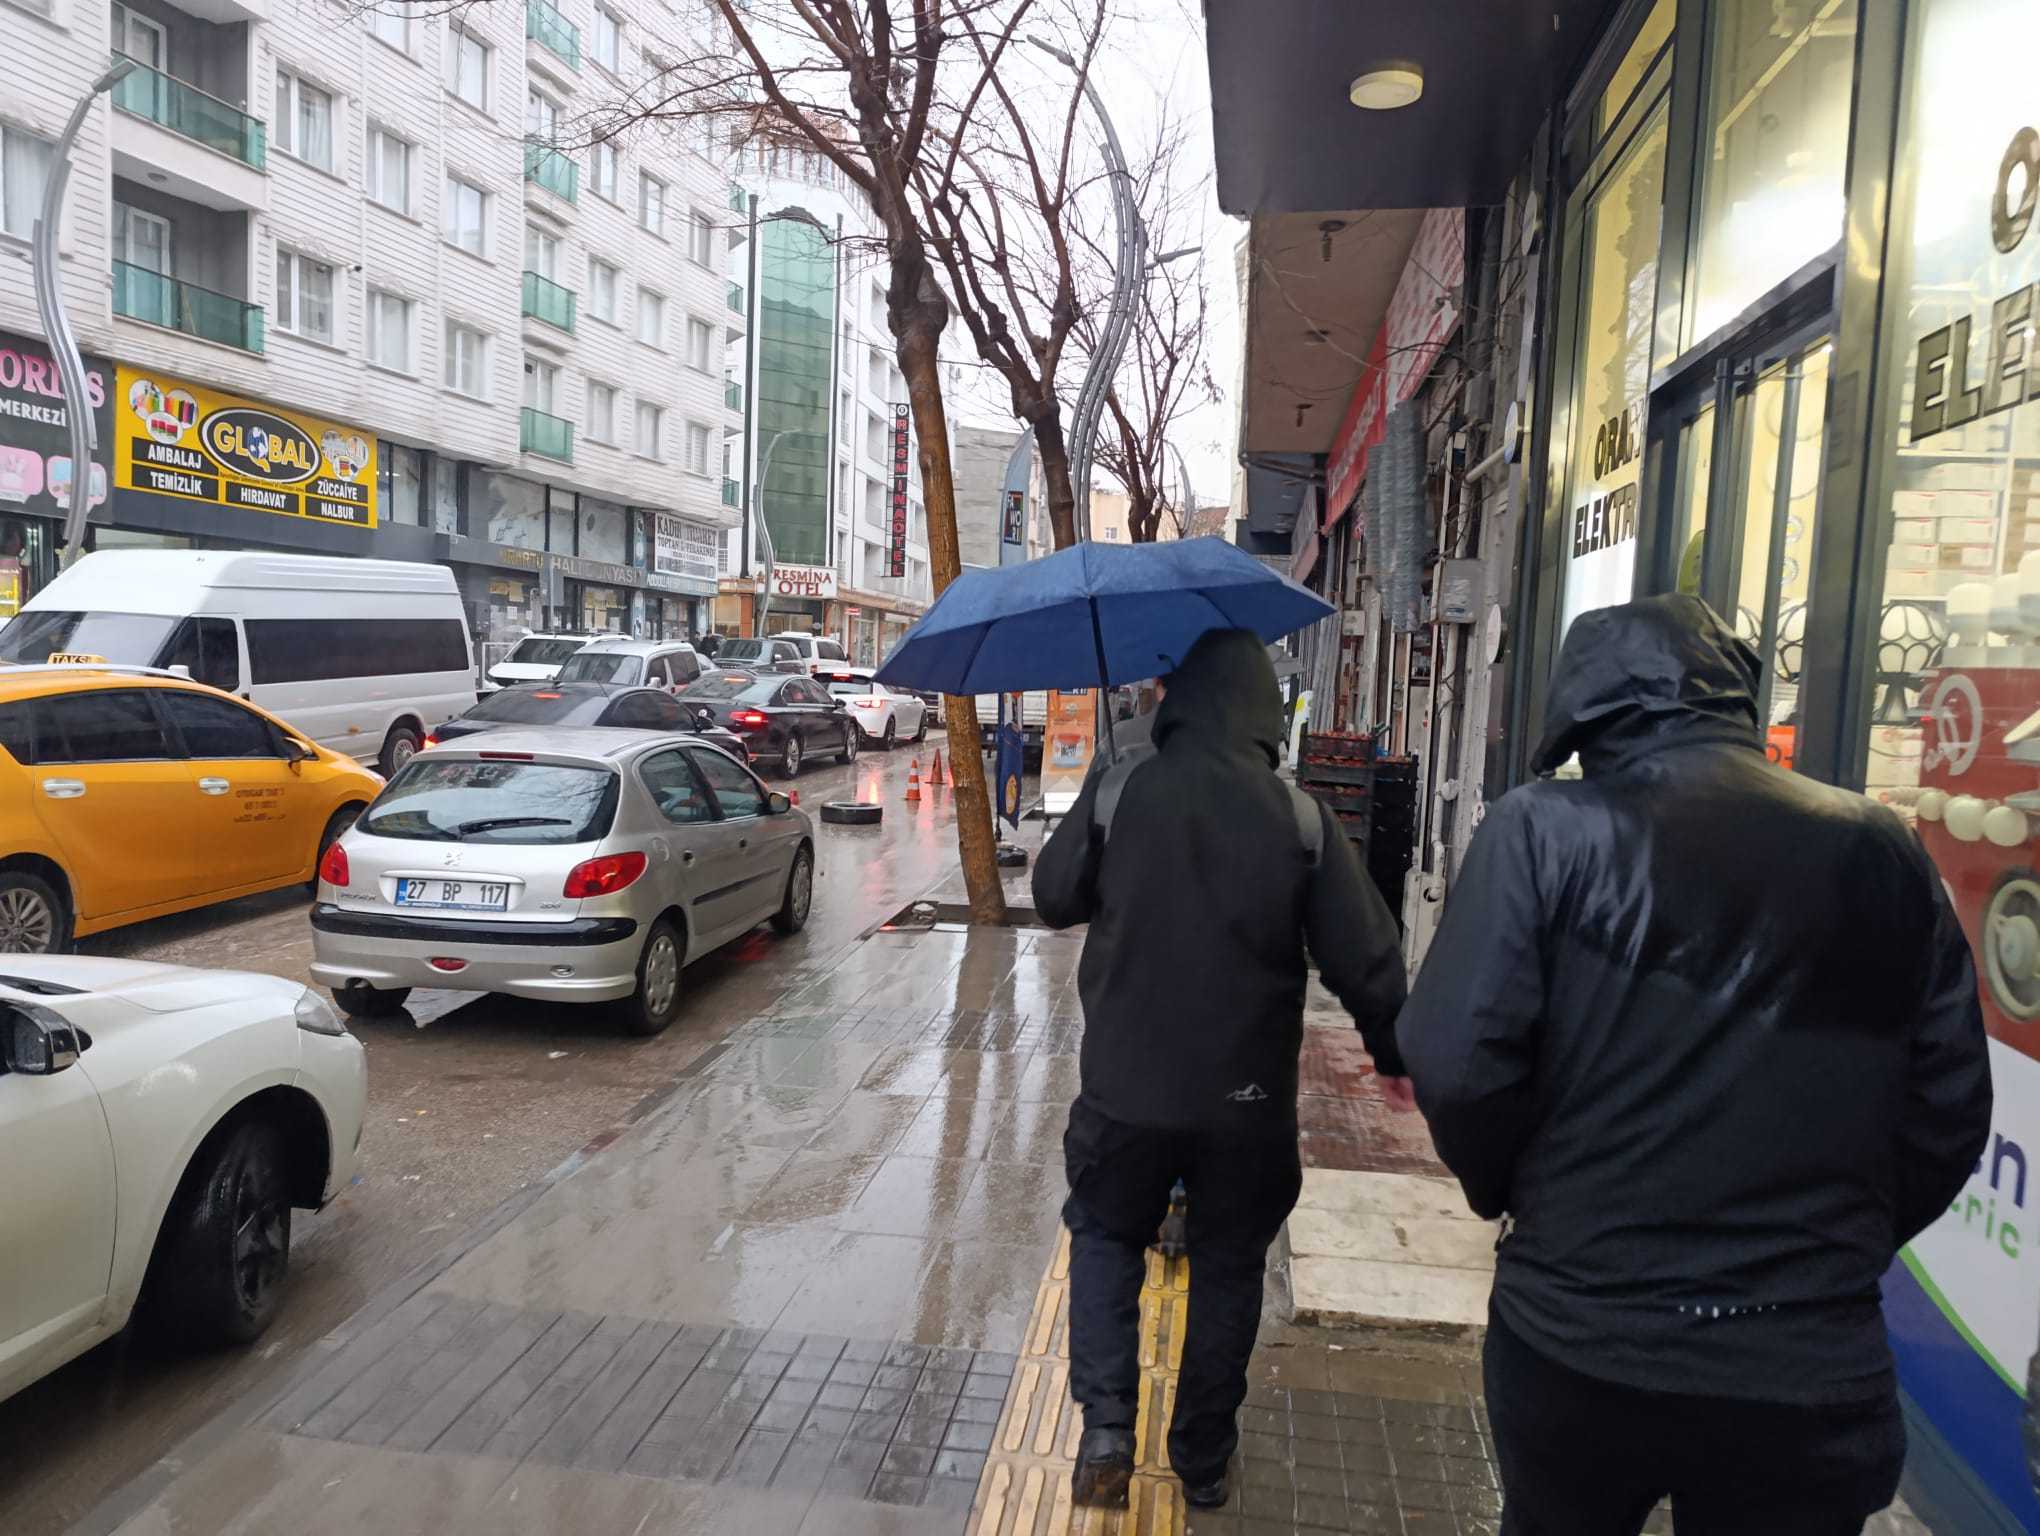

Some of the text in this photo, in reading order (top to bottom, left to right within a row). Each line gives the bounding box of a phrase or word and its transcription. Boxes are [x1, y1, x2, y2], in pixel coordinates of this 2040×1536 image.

[1910, 280, 2040, 442] ELE
[148, 444, 202, 469] AMBALAJ
[213, 422, 311, 472] GLOBAL
[150, 472, 202, 496] TEMİZLİK
[317, 479, 358, 501] ZÜCCAİYE
[321, 502, 354, 520] NALBUR
[1573, 481, 1637, 559] ELEKTR
[773, 568, 832, 584] RESMİNA
[778, 581, 823, 596] OTEL
[408, 880, 504, 904] 27 BP 117
[1951, 1195, 2020, 1259] ric
